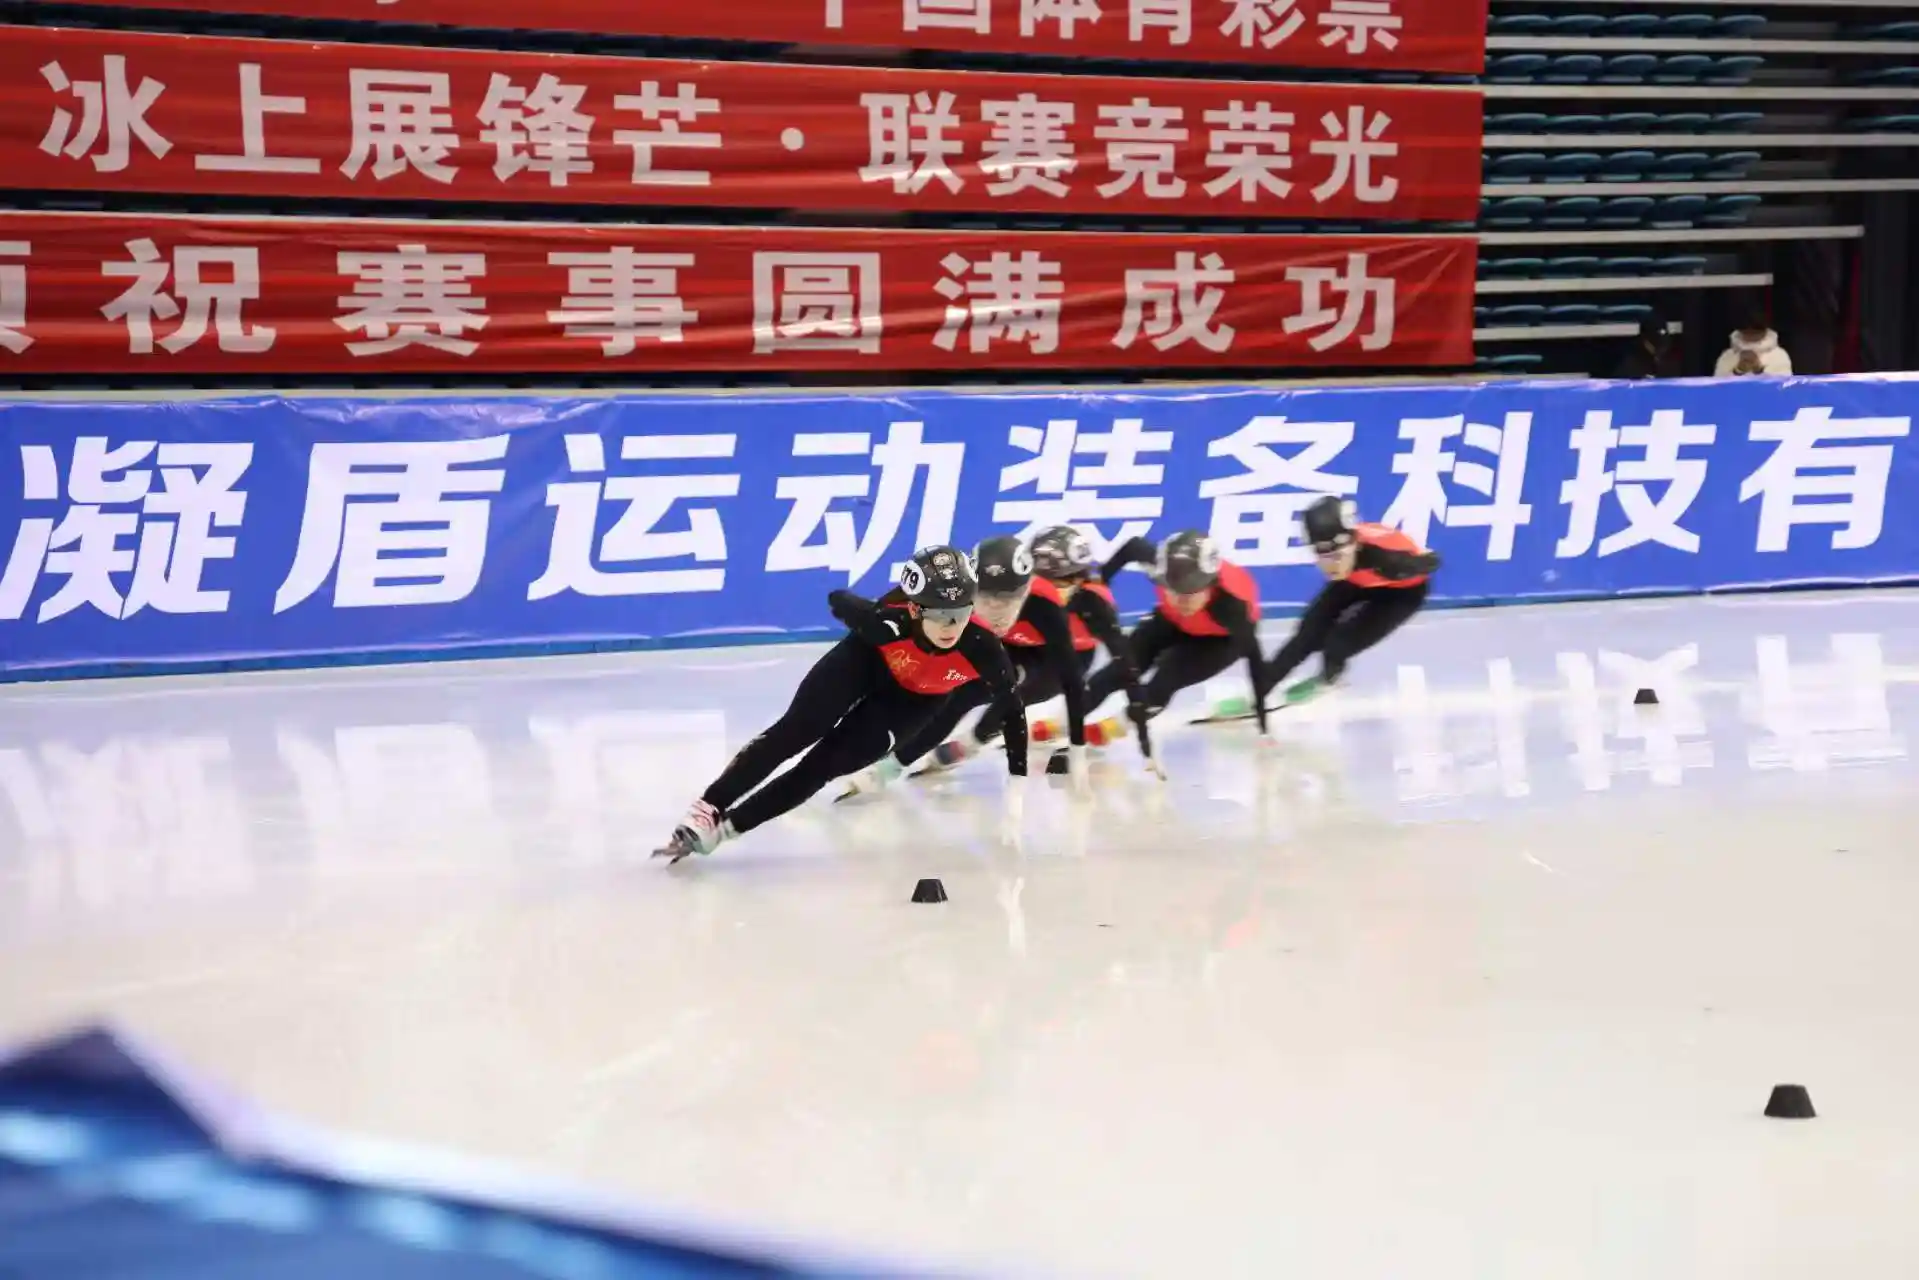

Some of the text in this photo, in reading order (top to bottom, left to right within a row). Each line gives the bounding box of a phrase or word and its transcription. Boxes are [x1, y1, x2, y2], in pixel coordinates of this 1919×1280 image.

[0, 238, 1397, 357] 祝赛事圆满成功
[0, 406, 1912, 624] 凝盾运动装备科技有
